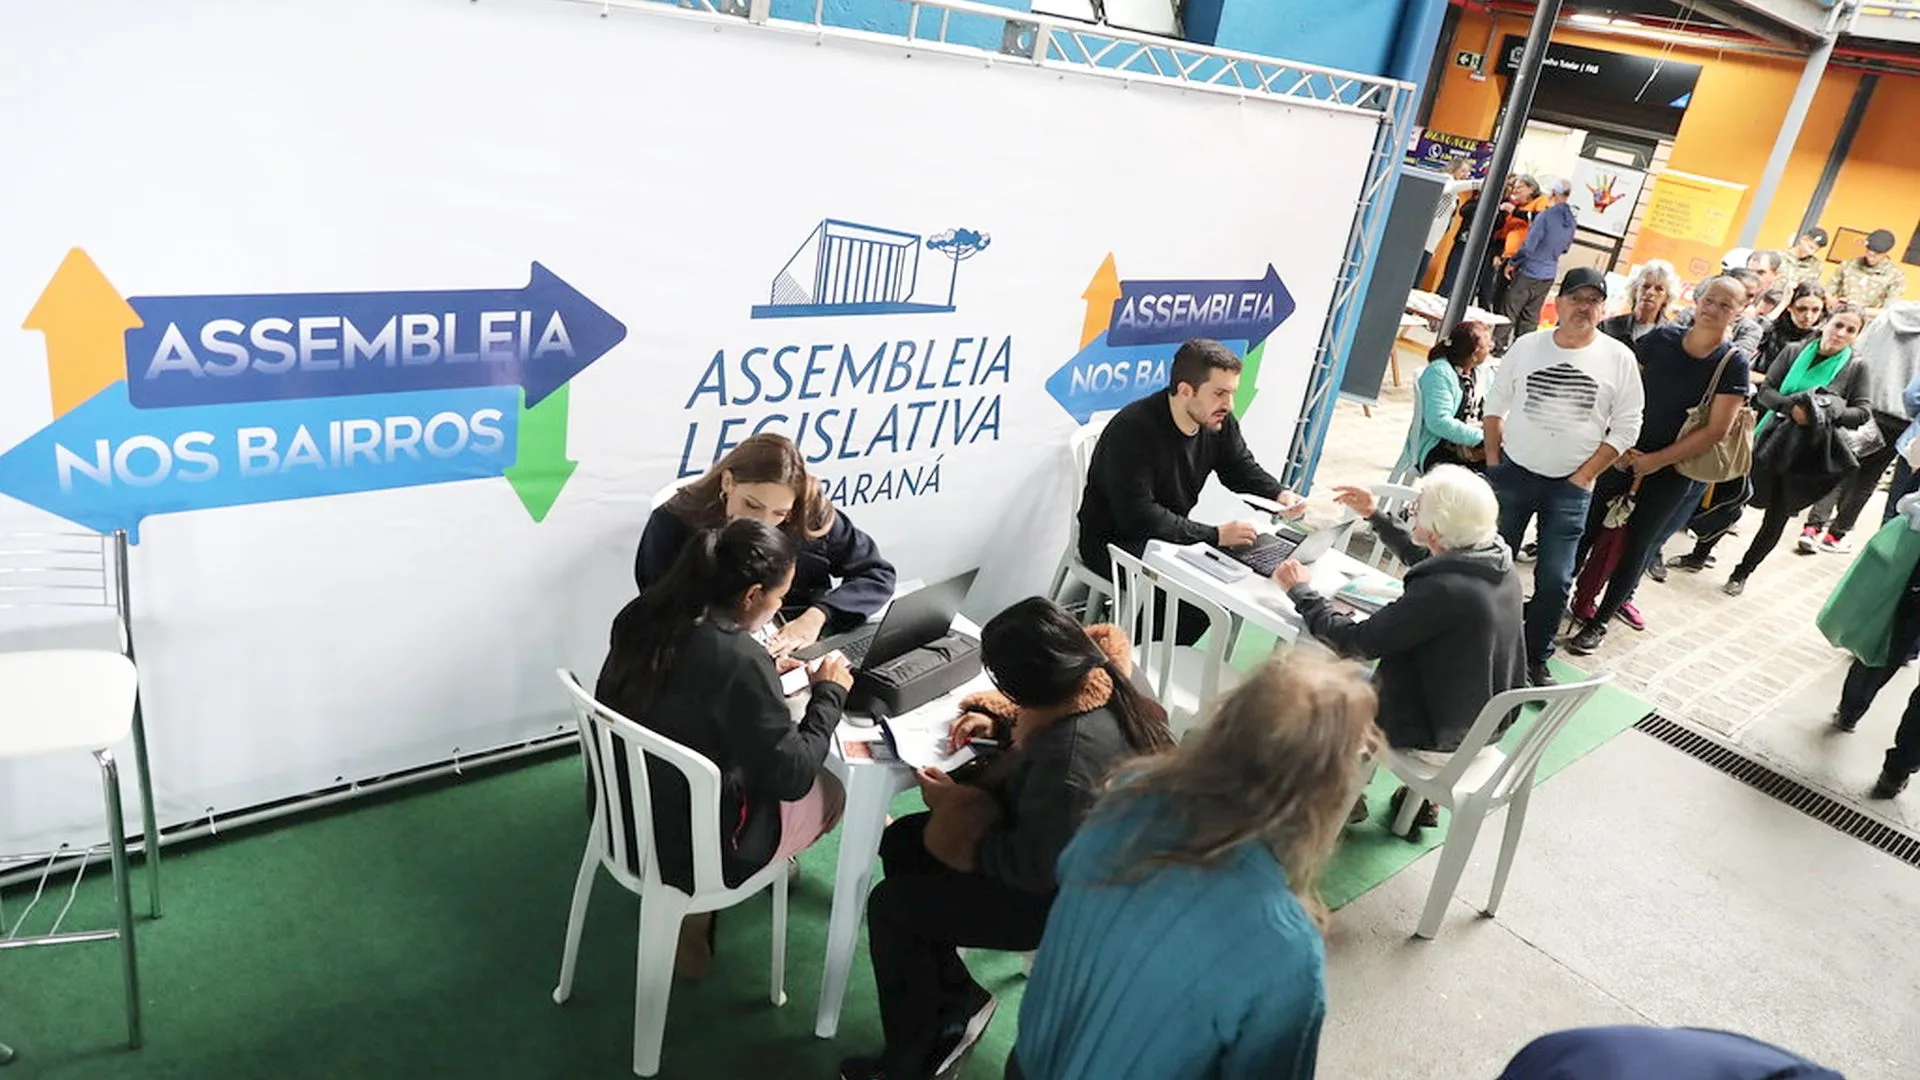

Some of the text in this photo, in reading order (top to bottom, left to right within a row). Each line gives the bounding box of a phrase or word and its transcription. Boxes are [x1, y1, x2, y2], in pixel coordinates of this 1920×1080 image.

[145, 310, 576, 381] ASSEMBLEIA
[1117, 293, 1274, 330] ASSEMBLEIA
[684, 335, 1012, 409] ASSEMBLEIA
[1069, 361, 1131, 396] NOS
[55, 409, 504, 494] NOS BAIRROS
